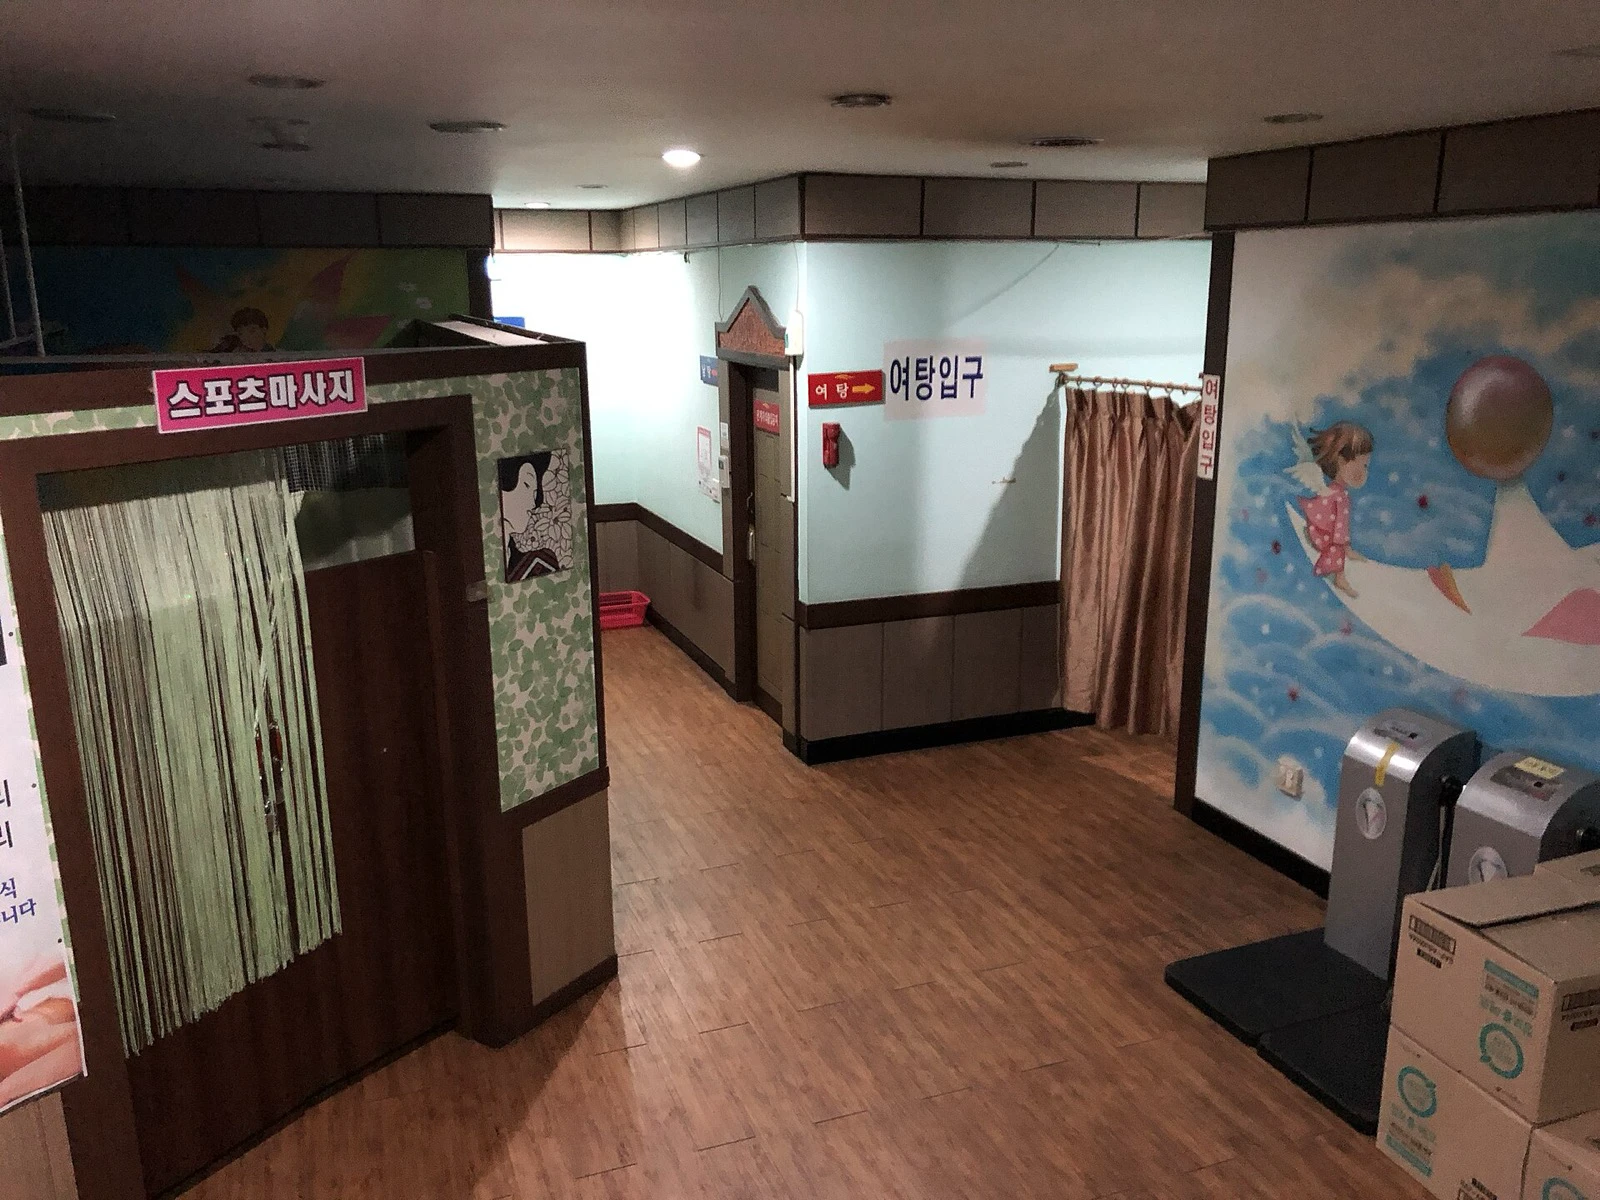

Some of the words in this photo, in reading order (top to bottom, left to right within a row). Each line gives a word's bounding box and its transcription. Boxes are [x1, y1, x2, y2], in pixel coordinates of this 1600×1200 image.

[168, 369, 356, 420] 스포츠마사지
[889, 355, 984, 401] 여탕입구
[1199, 378, 1219, 475] 여탕입구
[0, 898, 37, 924] 니다
